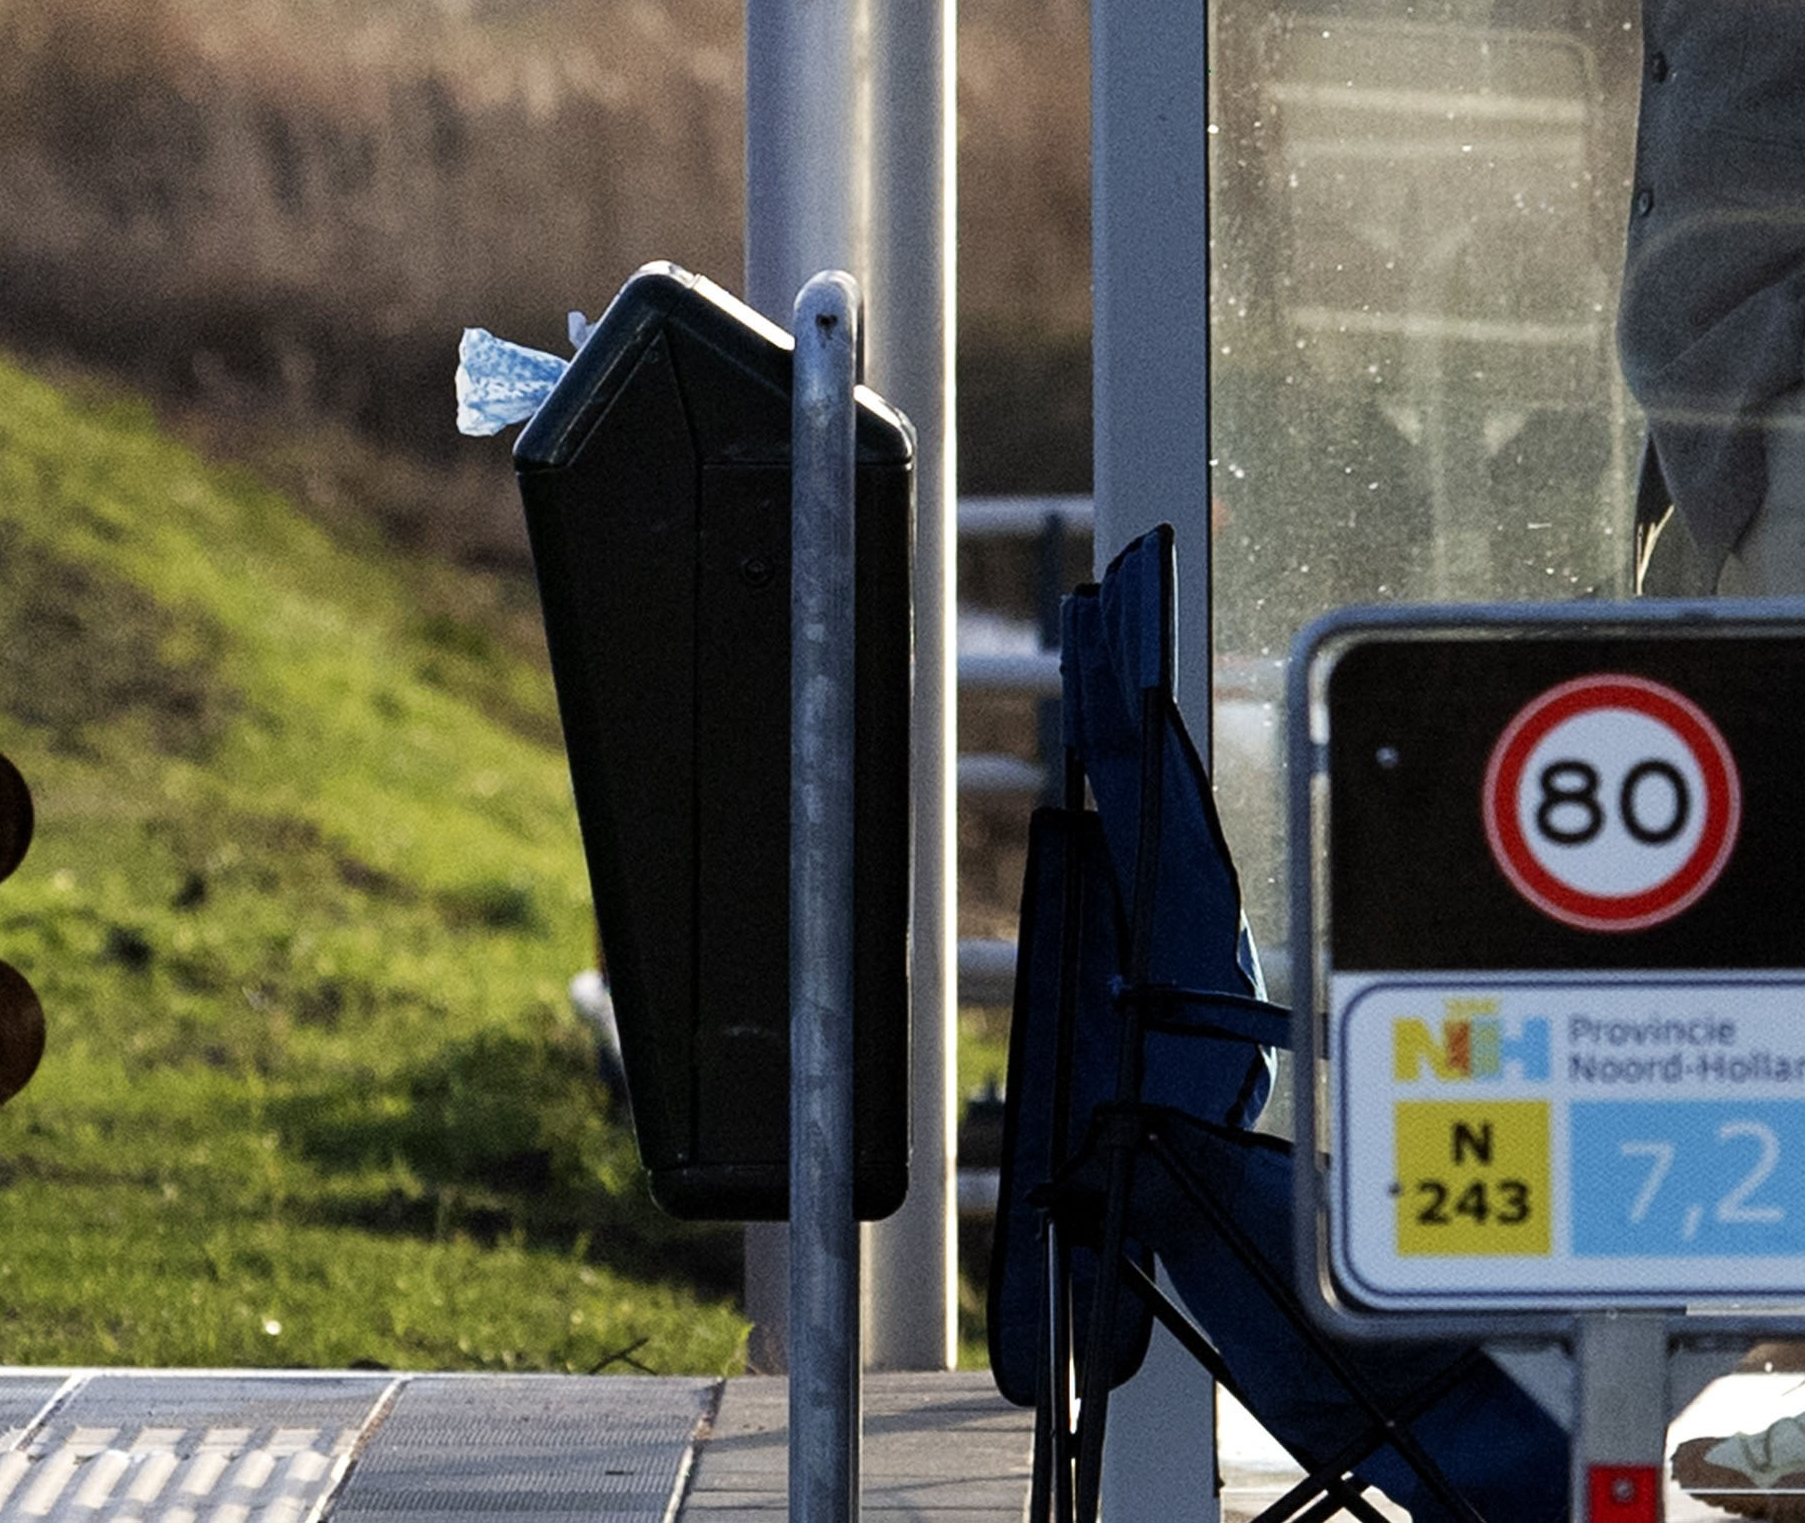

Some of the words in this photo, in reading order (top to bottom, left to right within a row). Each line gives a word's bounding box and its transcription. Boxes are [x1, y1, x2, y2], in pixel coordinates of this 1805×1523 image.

[1535, 759, 1692, 846] 80
[1567, 1013, 1738, 1046] Provincie
[1450, 1122, 1494, 1166] N
[1618, 1119, 1785, 1241] 7,2
[1414, 1181, 1534, 1226] 243
